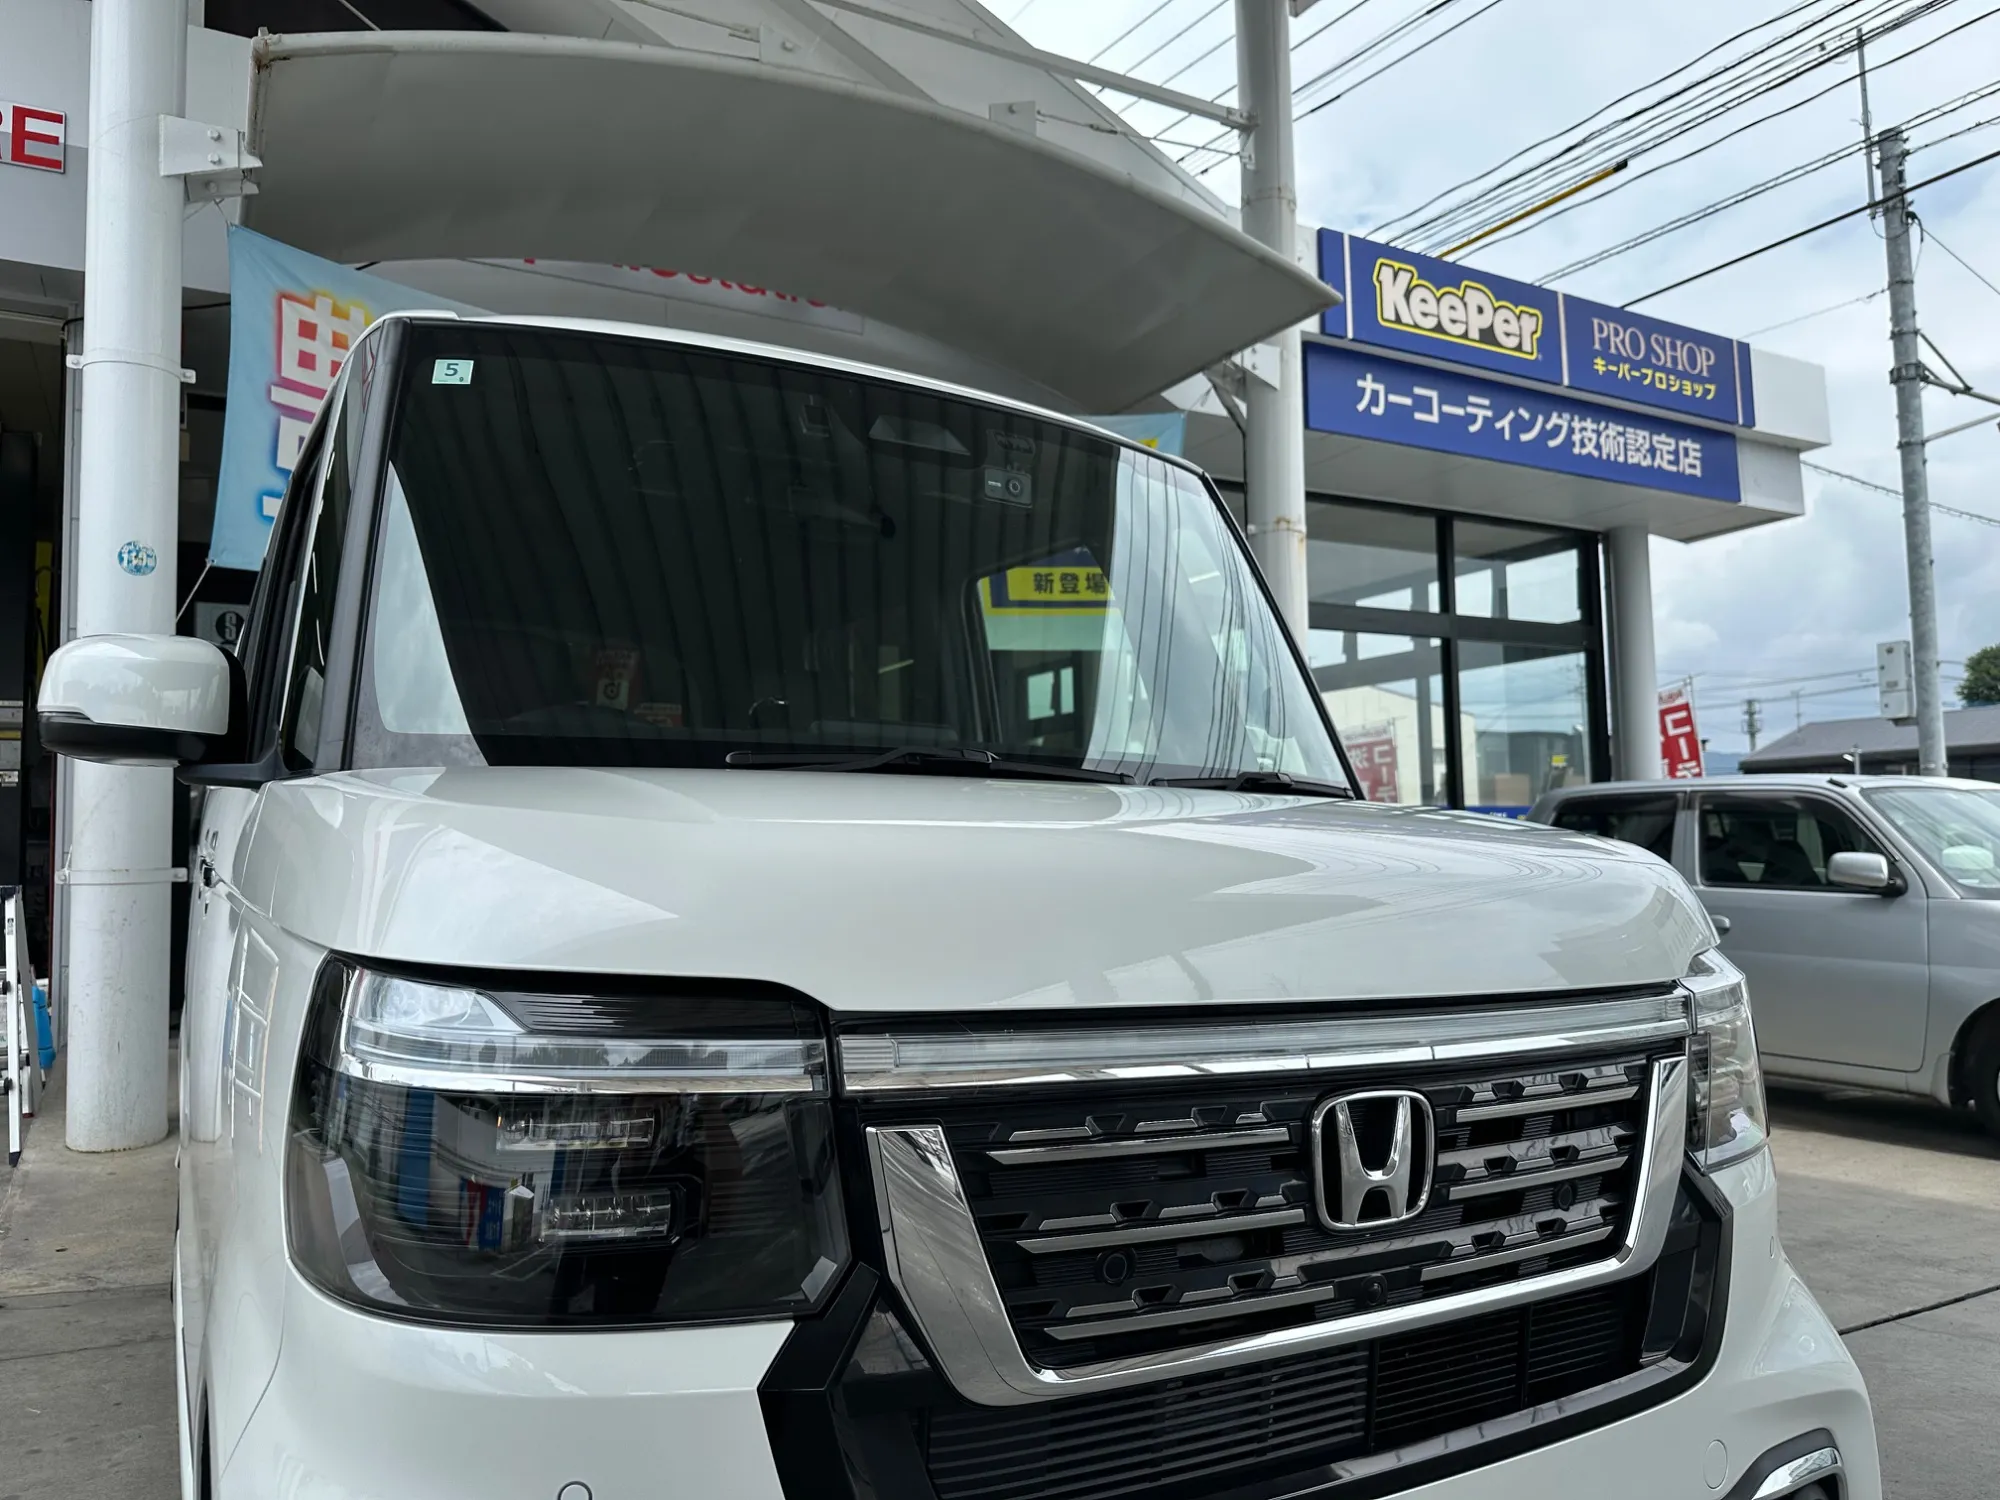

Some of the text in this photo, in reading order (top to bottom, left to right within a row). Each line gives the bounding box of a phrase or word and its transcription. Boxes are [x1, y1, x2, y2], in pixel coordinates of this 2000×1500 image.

[0, 105, 64, 170] E
[1375, 260, 1541, 357] KeePer
[444, 362, 459, 377] 5
[1592, 317, 1716, 377] PRO SHOP
[1356, 373, 1703, 478] カーコーティング技術認定店
[1033, 572, 1107, 594] 新登場
